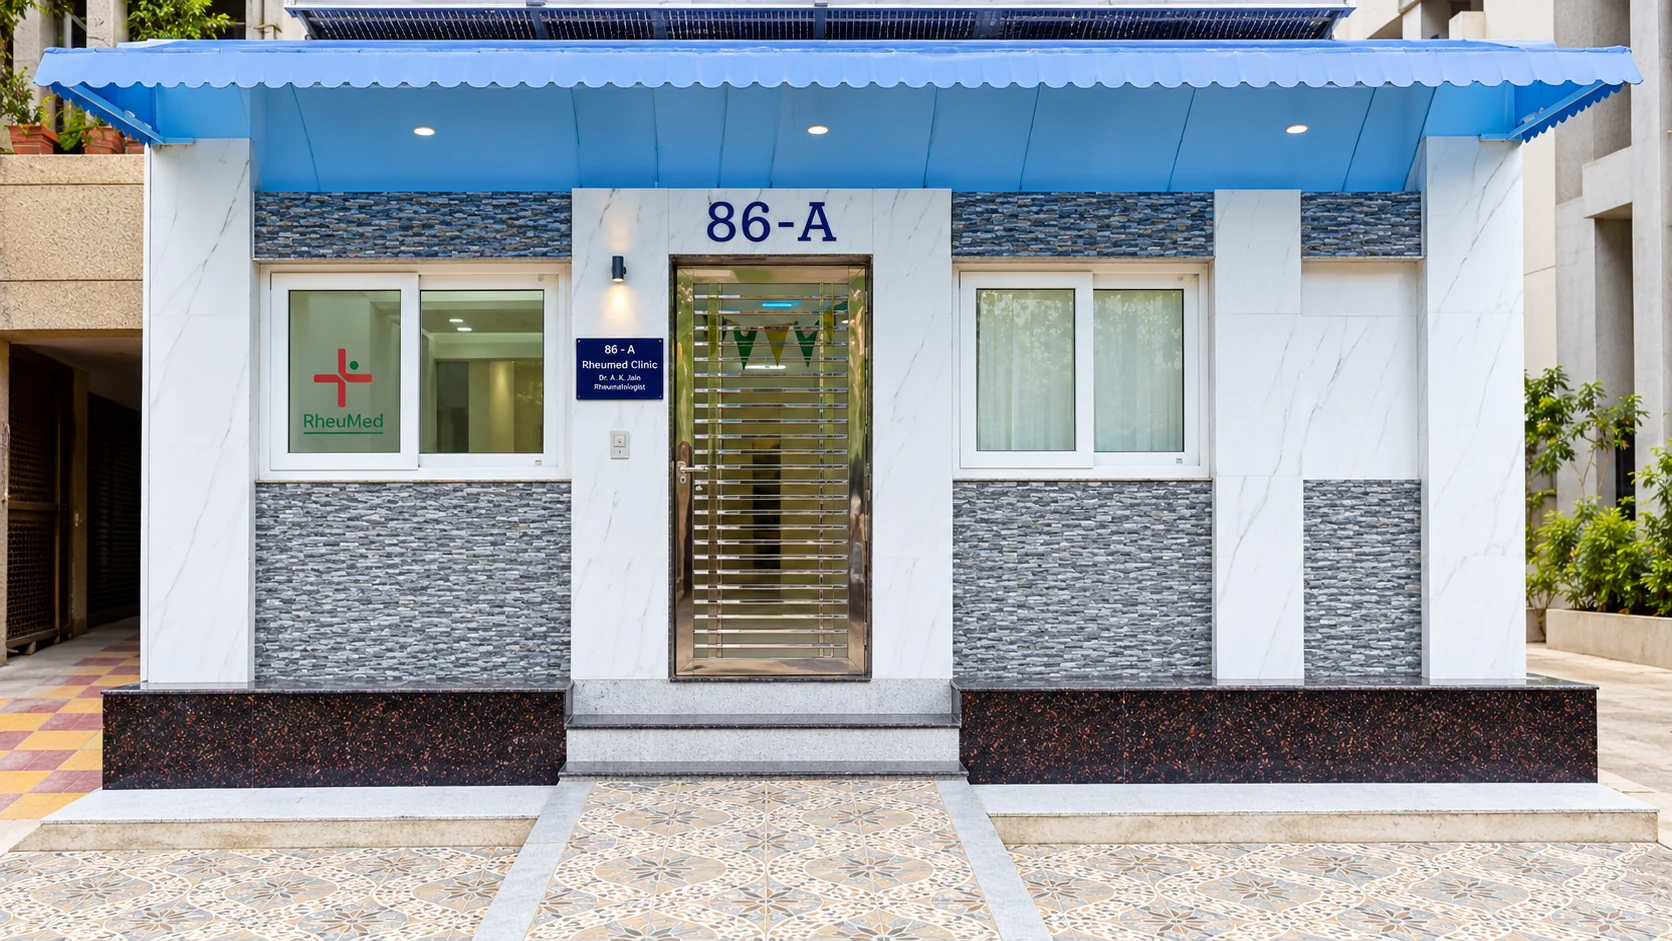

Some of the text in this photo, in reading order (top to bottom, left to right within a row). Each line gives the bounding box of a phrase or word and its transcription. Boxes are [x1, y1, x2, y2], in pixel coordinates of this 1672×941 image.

[707, 201, 837, 242] 86-A
[604, 345, 618, 354] 86
[627, 345, 636, 354] A
[582, 360, 658, 369] Rheumed Clinic
[594, 382, 646, 392] Rheumatologist
[303, 413, 384, 429] RheuMed
